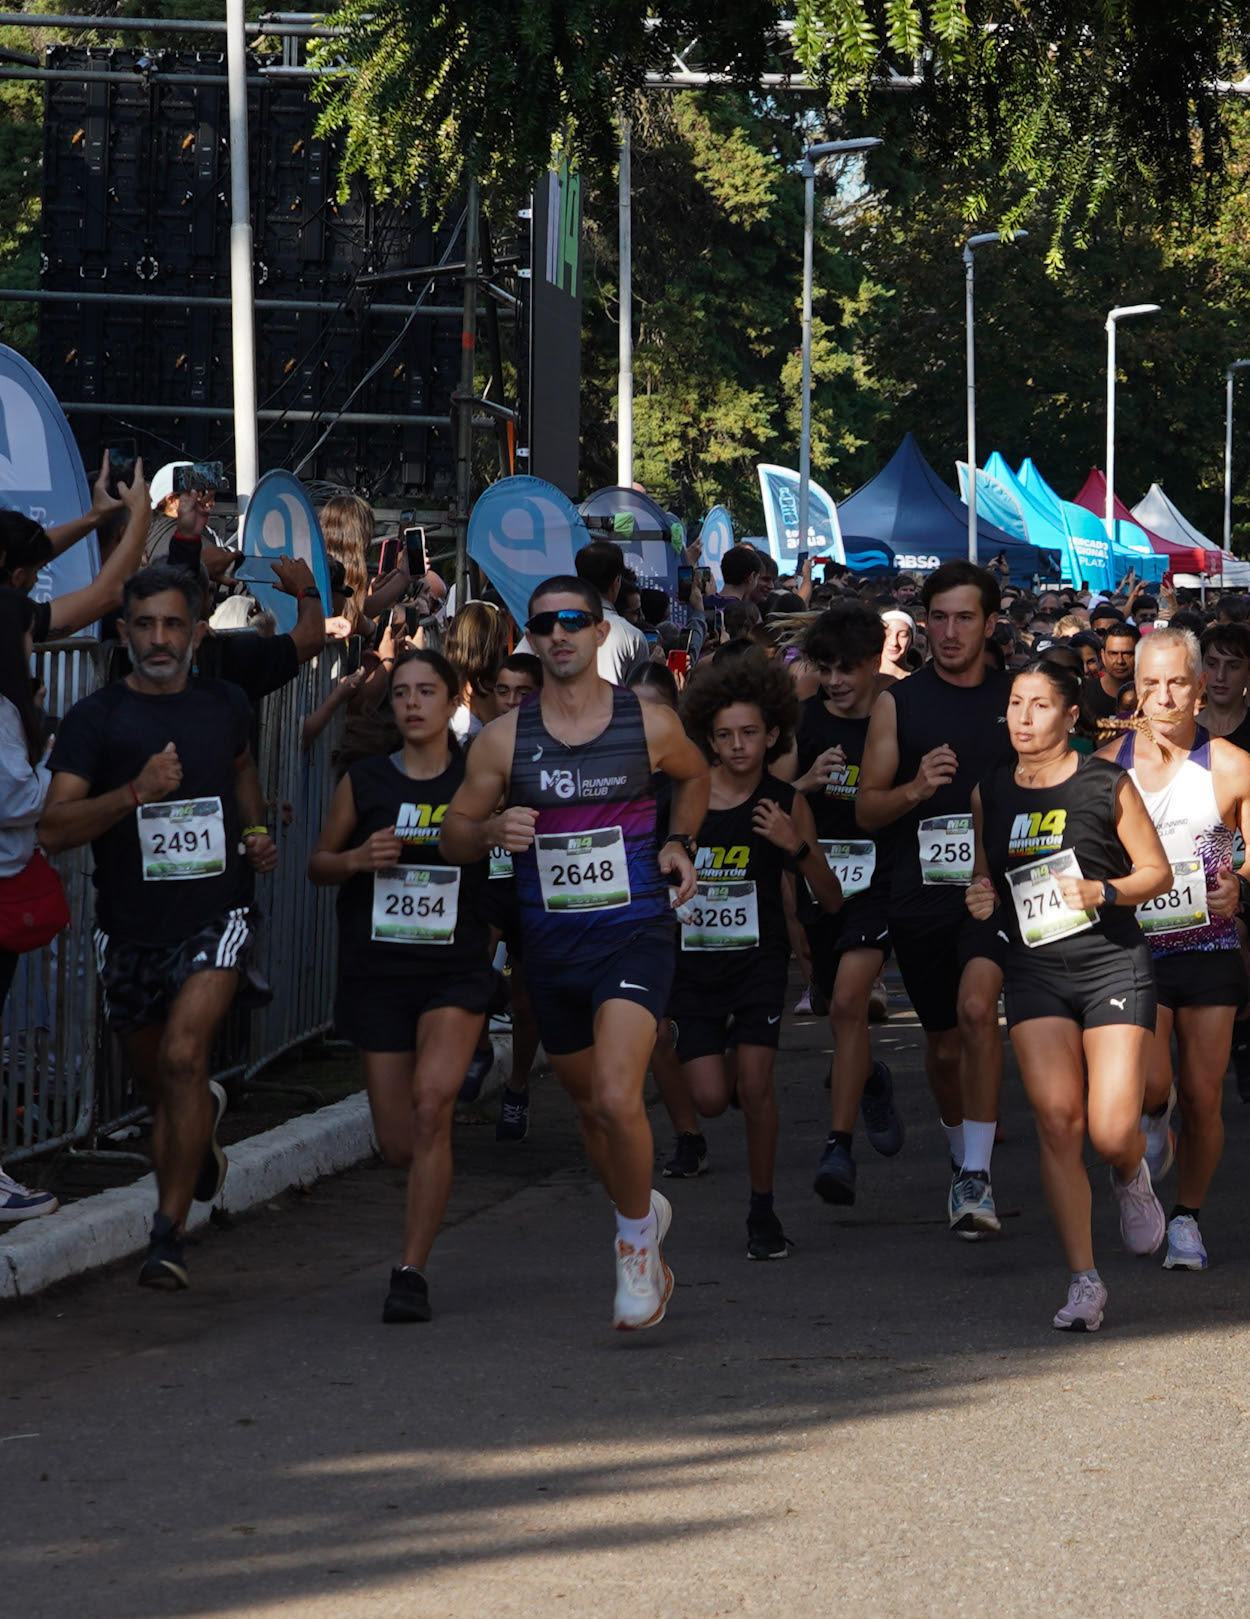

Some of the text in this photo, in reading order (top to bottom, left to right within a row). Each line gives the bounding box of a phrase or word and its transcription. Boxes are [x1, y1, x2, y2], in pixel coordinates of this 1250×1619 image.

[893, 555, 941, 569] ABSA
[581, 776, 627, 788] RUNNING
[582, 787, 608, 797] CLUB
[826, 784, 858, 795] MARA
[394, 827, 440, 837] MARAT
[1010, 809, 1067, 839] M14
[152, 828, 211, 855] 2491
[694, 846, 750, 869] M14
[930, 842, 972, 863] 258
[550, 860, 614, 886] 2648
[385, 894, 445, 917] 2854
[1024, 889, 1061, 919] 274
[693, 907, 747, 927] 3265
